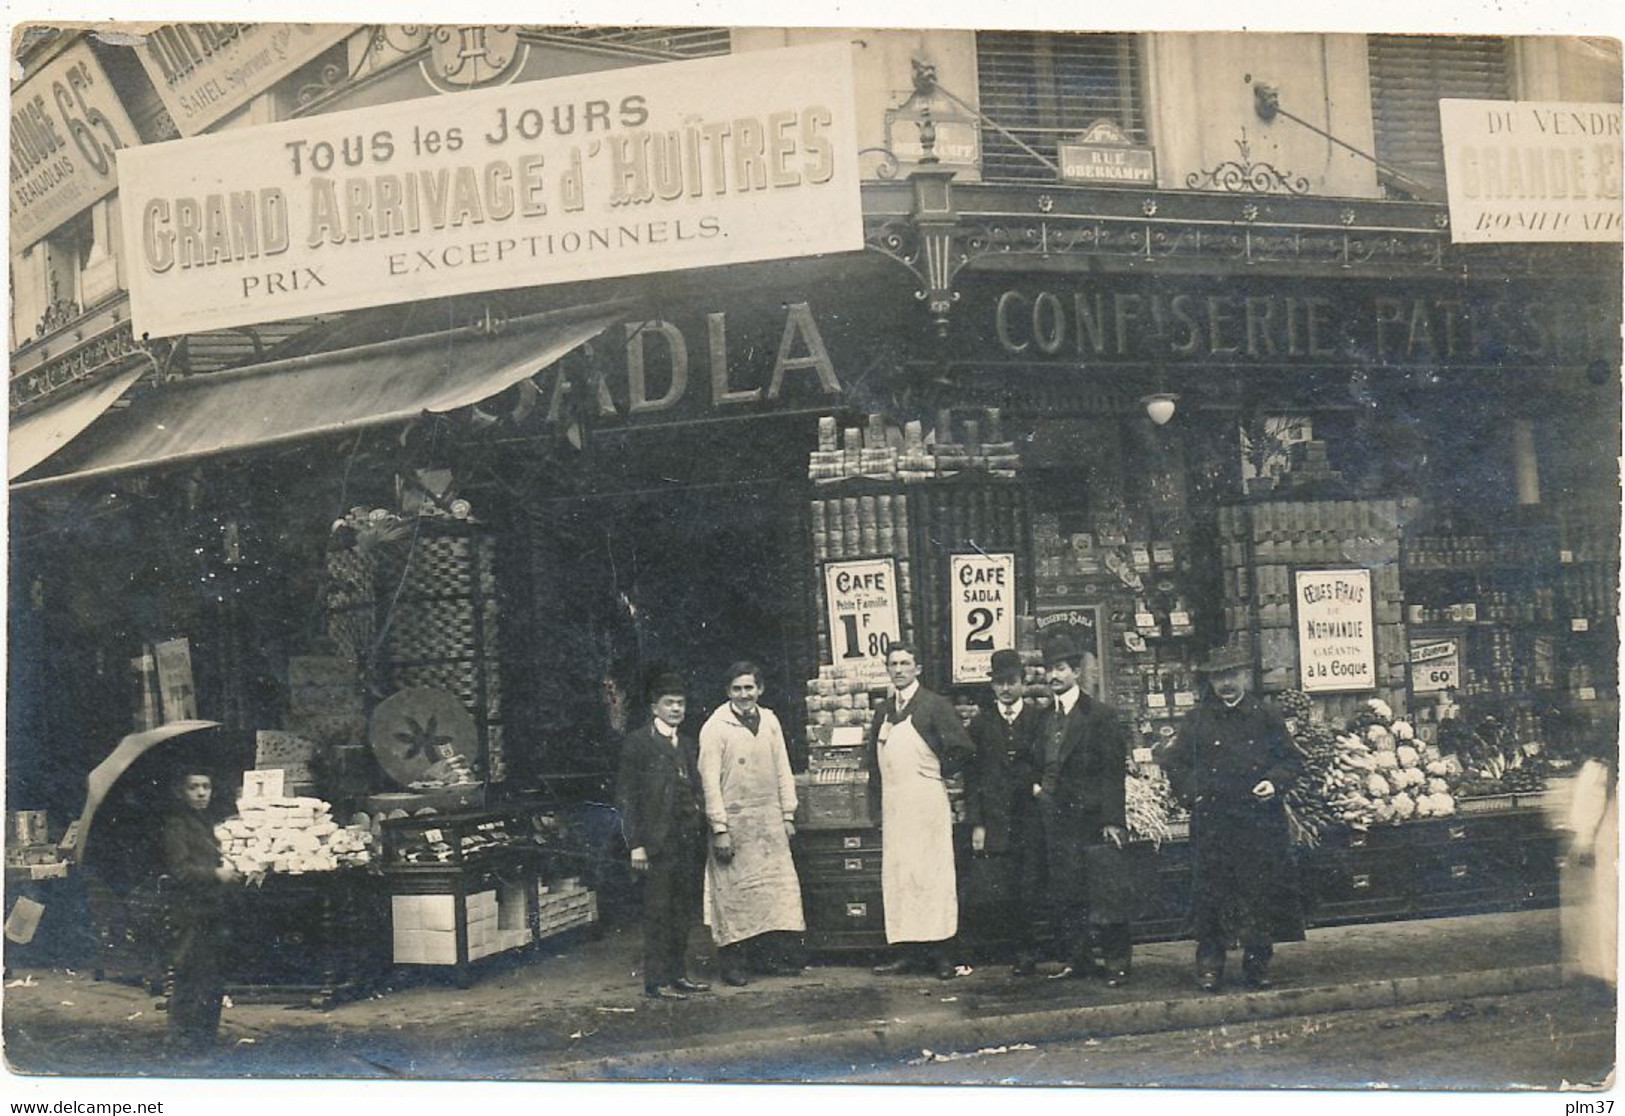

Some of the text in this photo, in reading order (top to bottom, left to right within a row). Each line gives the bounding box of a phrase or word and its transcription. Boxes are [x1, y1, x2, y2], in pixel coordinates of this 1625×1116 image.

[285, 95, 650, 175] TOUS les JOURS
[1091, 150, 1126, 166] RUE
[15, 155, 75, 207] BEAUJOLAIS
[1065, 164, 1150, 181] OBERKAMPF
[143, 187, 290, 273] GRAND
[306, 154, 547, 249] ARRIVAGE
[242, 216, 729, 298] PRIX EXCEPTIONNELS.
[837, 571, 885, 593] CAFE
[960, 564, 1005, 587] CAFE
[963, 589, 1002, 603] SADLA
[1307, 619, 1363, 639] NORMANDIE
[1318, 662, 1327, 677] la
[1331, 660, 1367, 678] Coque
